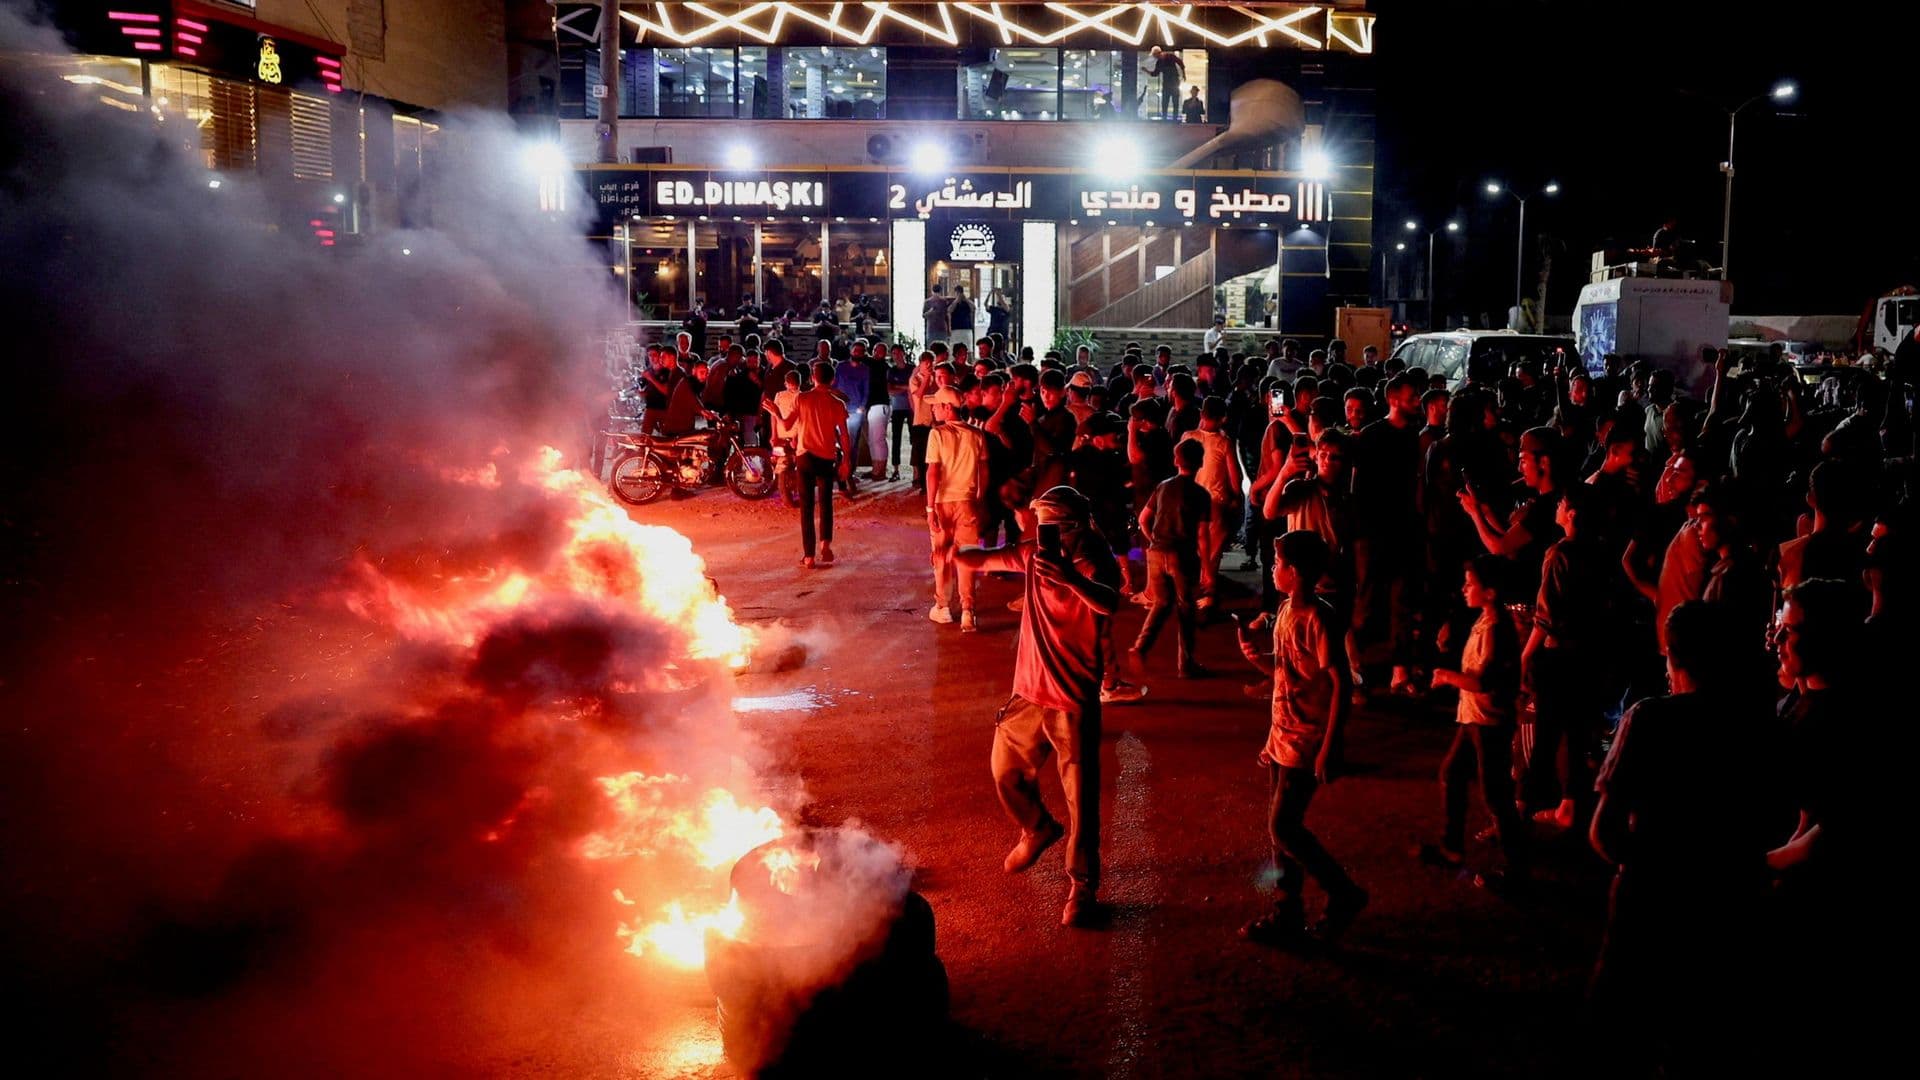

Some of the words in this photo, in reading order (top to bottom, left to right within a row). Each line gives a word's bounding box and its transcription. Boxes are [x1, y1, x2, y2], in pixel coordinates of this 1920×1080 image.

[657, 181, 823, 211] ED.DIMAŞKI
[889, 184, 907, 209] 2
[915, 178, 1032, 219] الدمشقي
[1080, 185, 1161, 217] مندي
[1174, 189, 1196, 217] و
[1209, 186, 1291, 218] مطبخ
